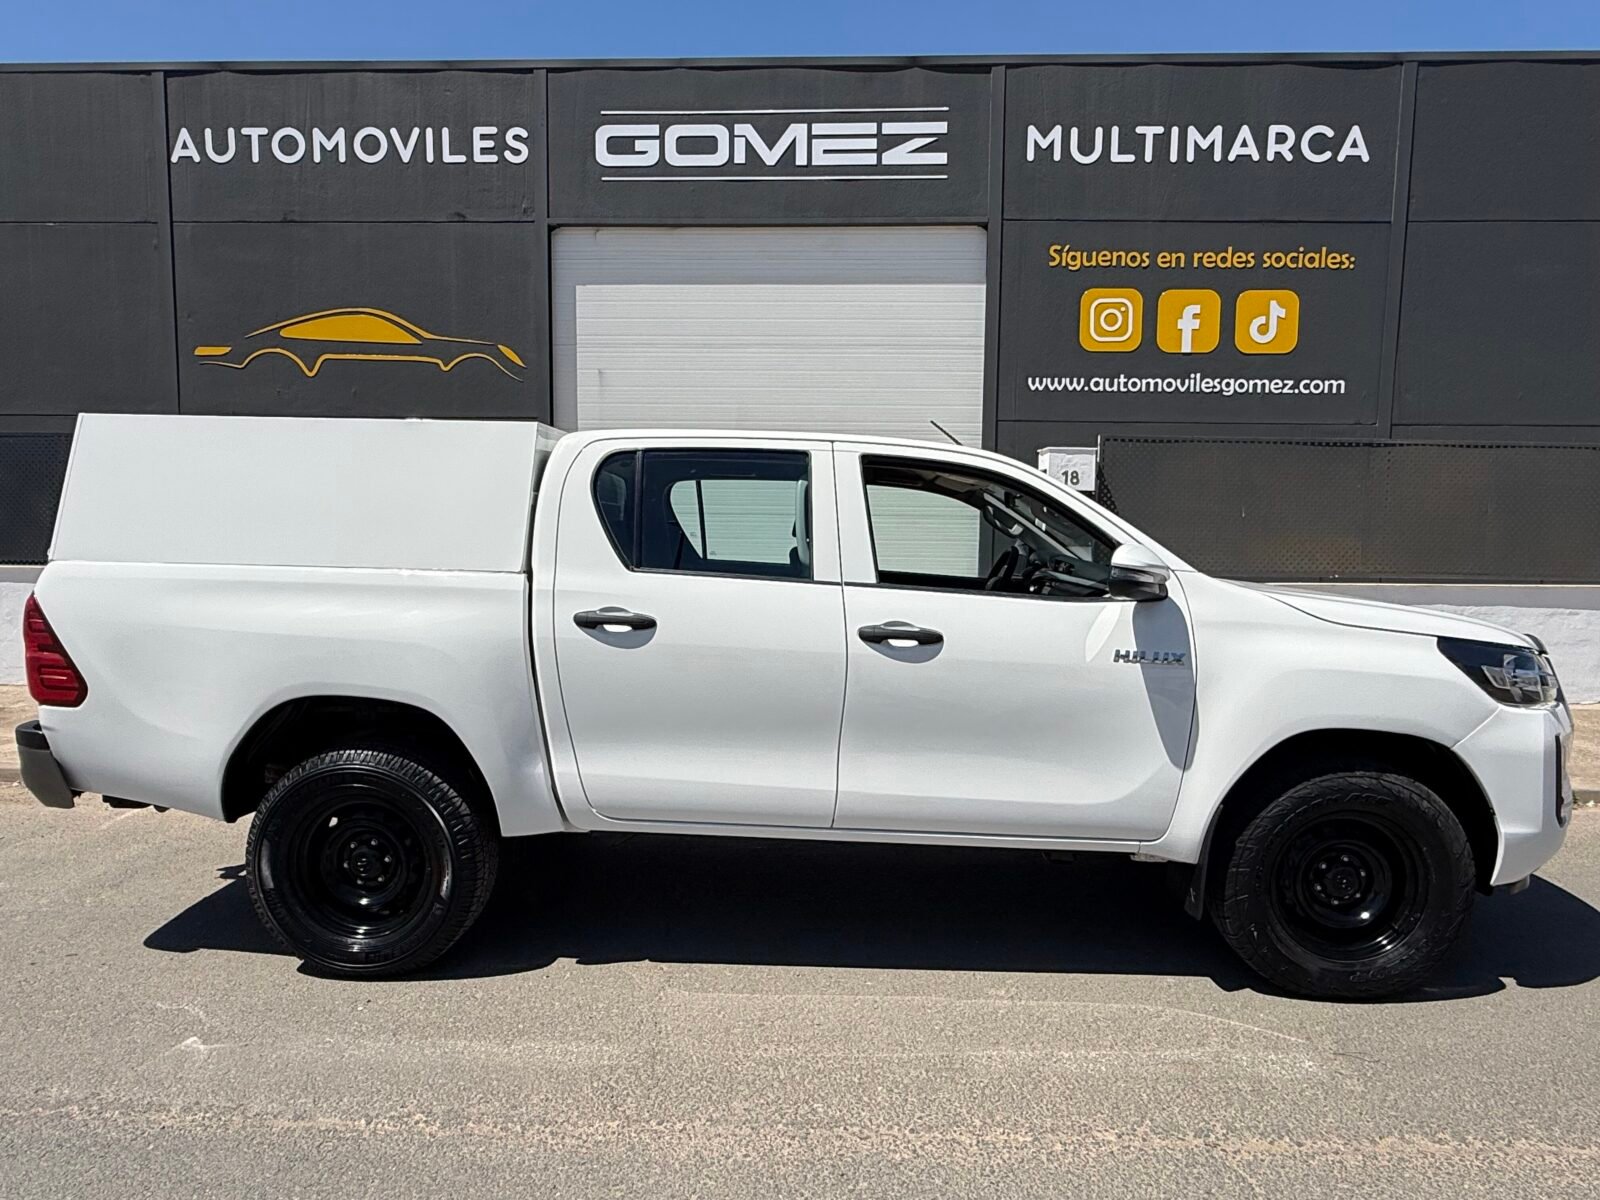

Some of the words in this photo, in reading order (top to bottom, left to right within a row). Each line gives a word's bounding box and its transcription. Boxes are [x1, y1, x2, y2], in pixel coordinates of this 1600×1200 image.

[171, 126, 529, 164] AUTOMOVILES
[594, 121, 948, 167] GOMEZ
[1026, 124, 1370, 165] MULTIMARCA
[1048, 244, 1149, 271] Síguenos
[1156, 251, 1186, 269] en
[1192, 246, 1256, 269] redes
[1262, 246, 1356, 270] sociales:
[1027, 372, 1346, 396] www.automovilesgomez.com
[1061, 470, 1080, 486] 18
[1113, 649, 1186, 666] HILUX
